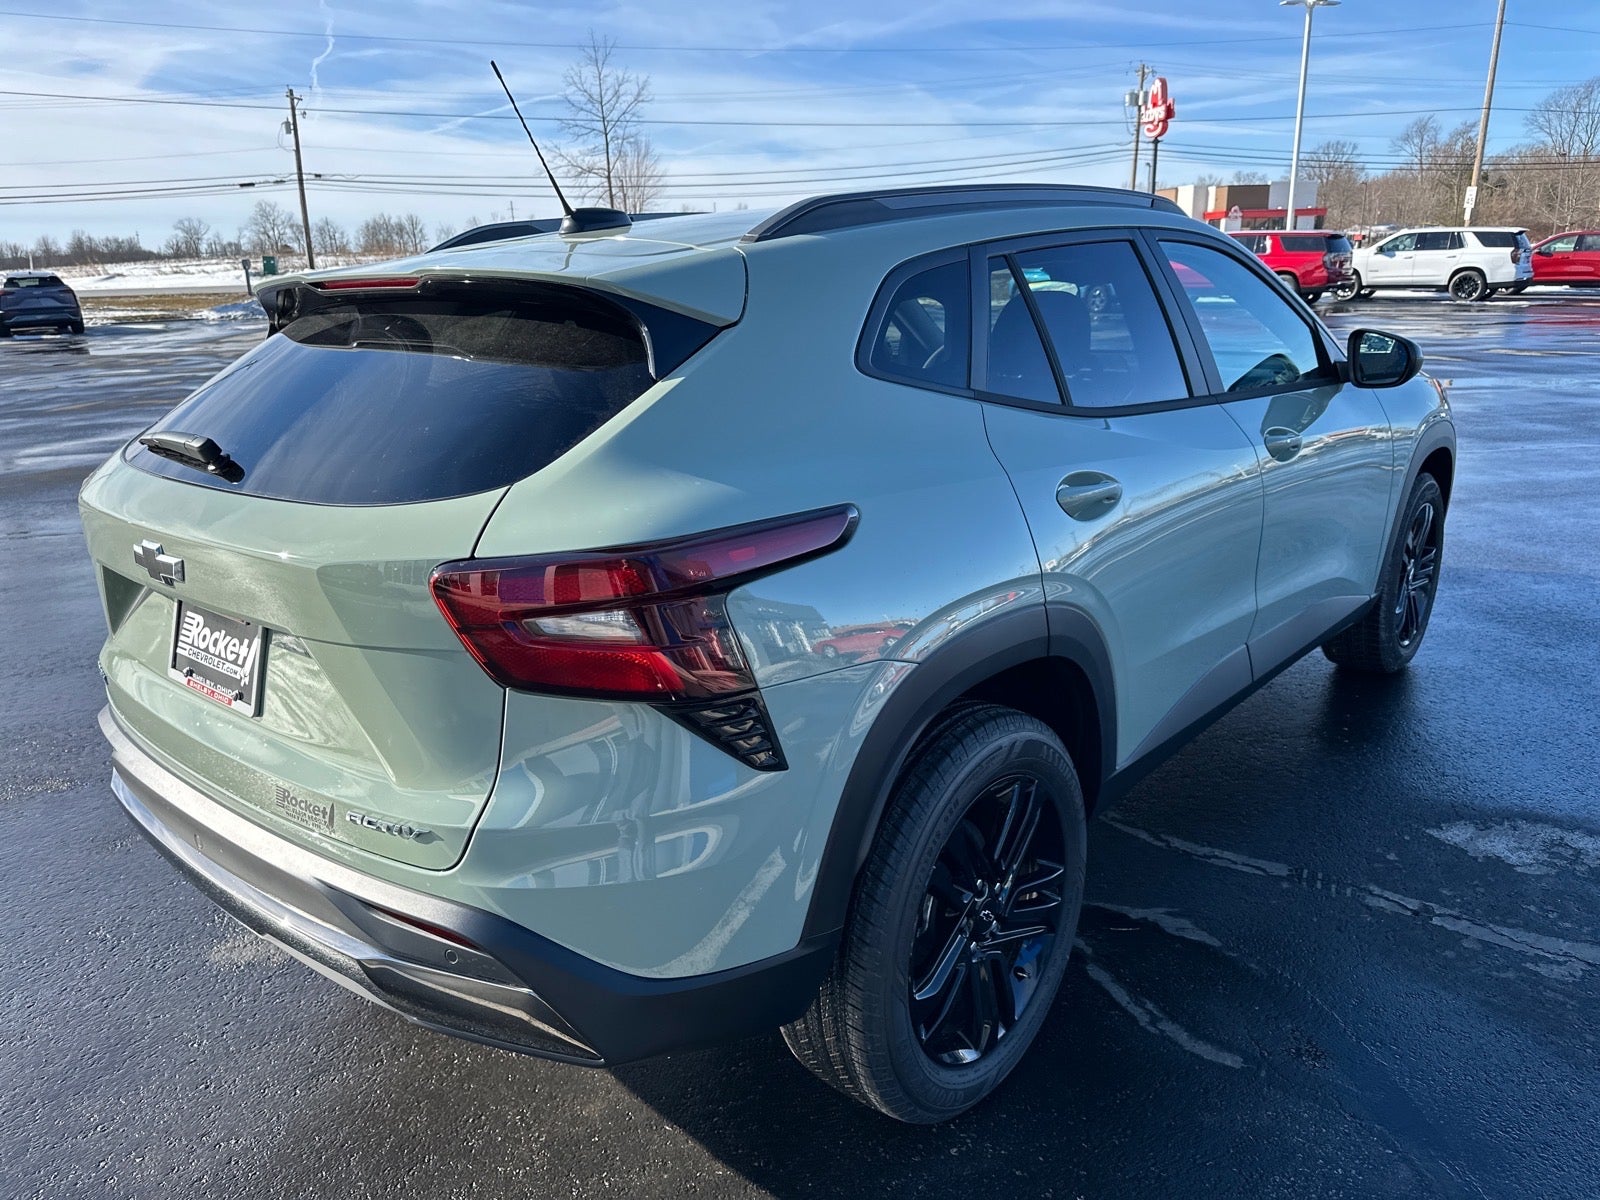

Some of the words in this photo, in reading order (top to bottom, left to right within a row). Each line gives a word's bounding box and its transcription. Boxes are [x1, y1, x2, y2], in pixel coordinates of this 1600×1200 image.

[178, 610, 250, 665] Rocket
[187, 648, 239, 676] CHEVROLET.COM
[276, 786, 328, 819] Rocket
